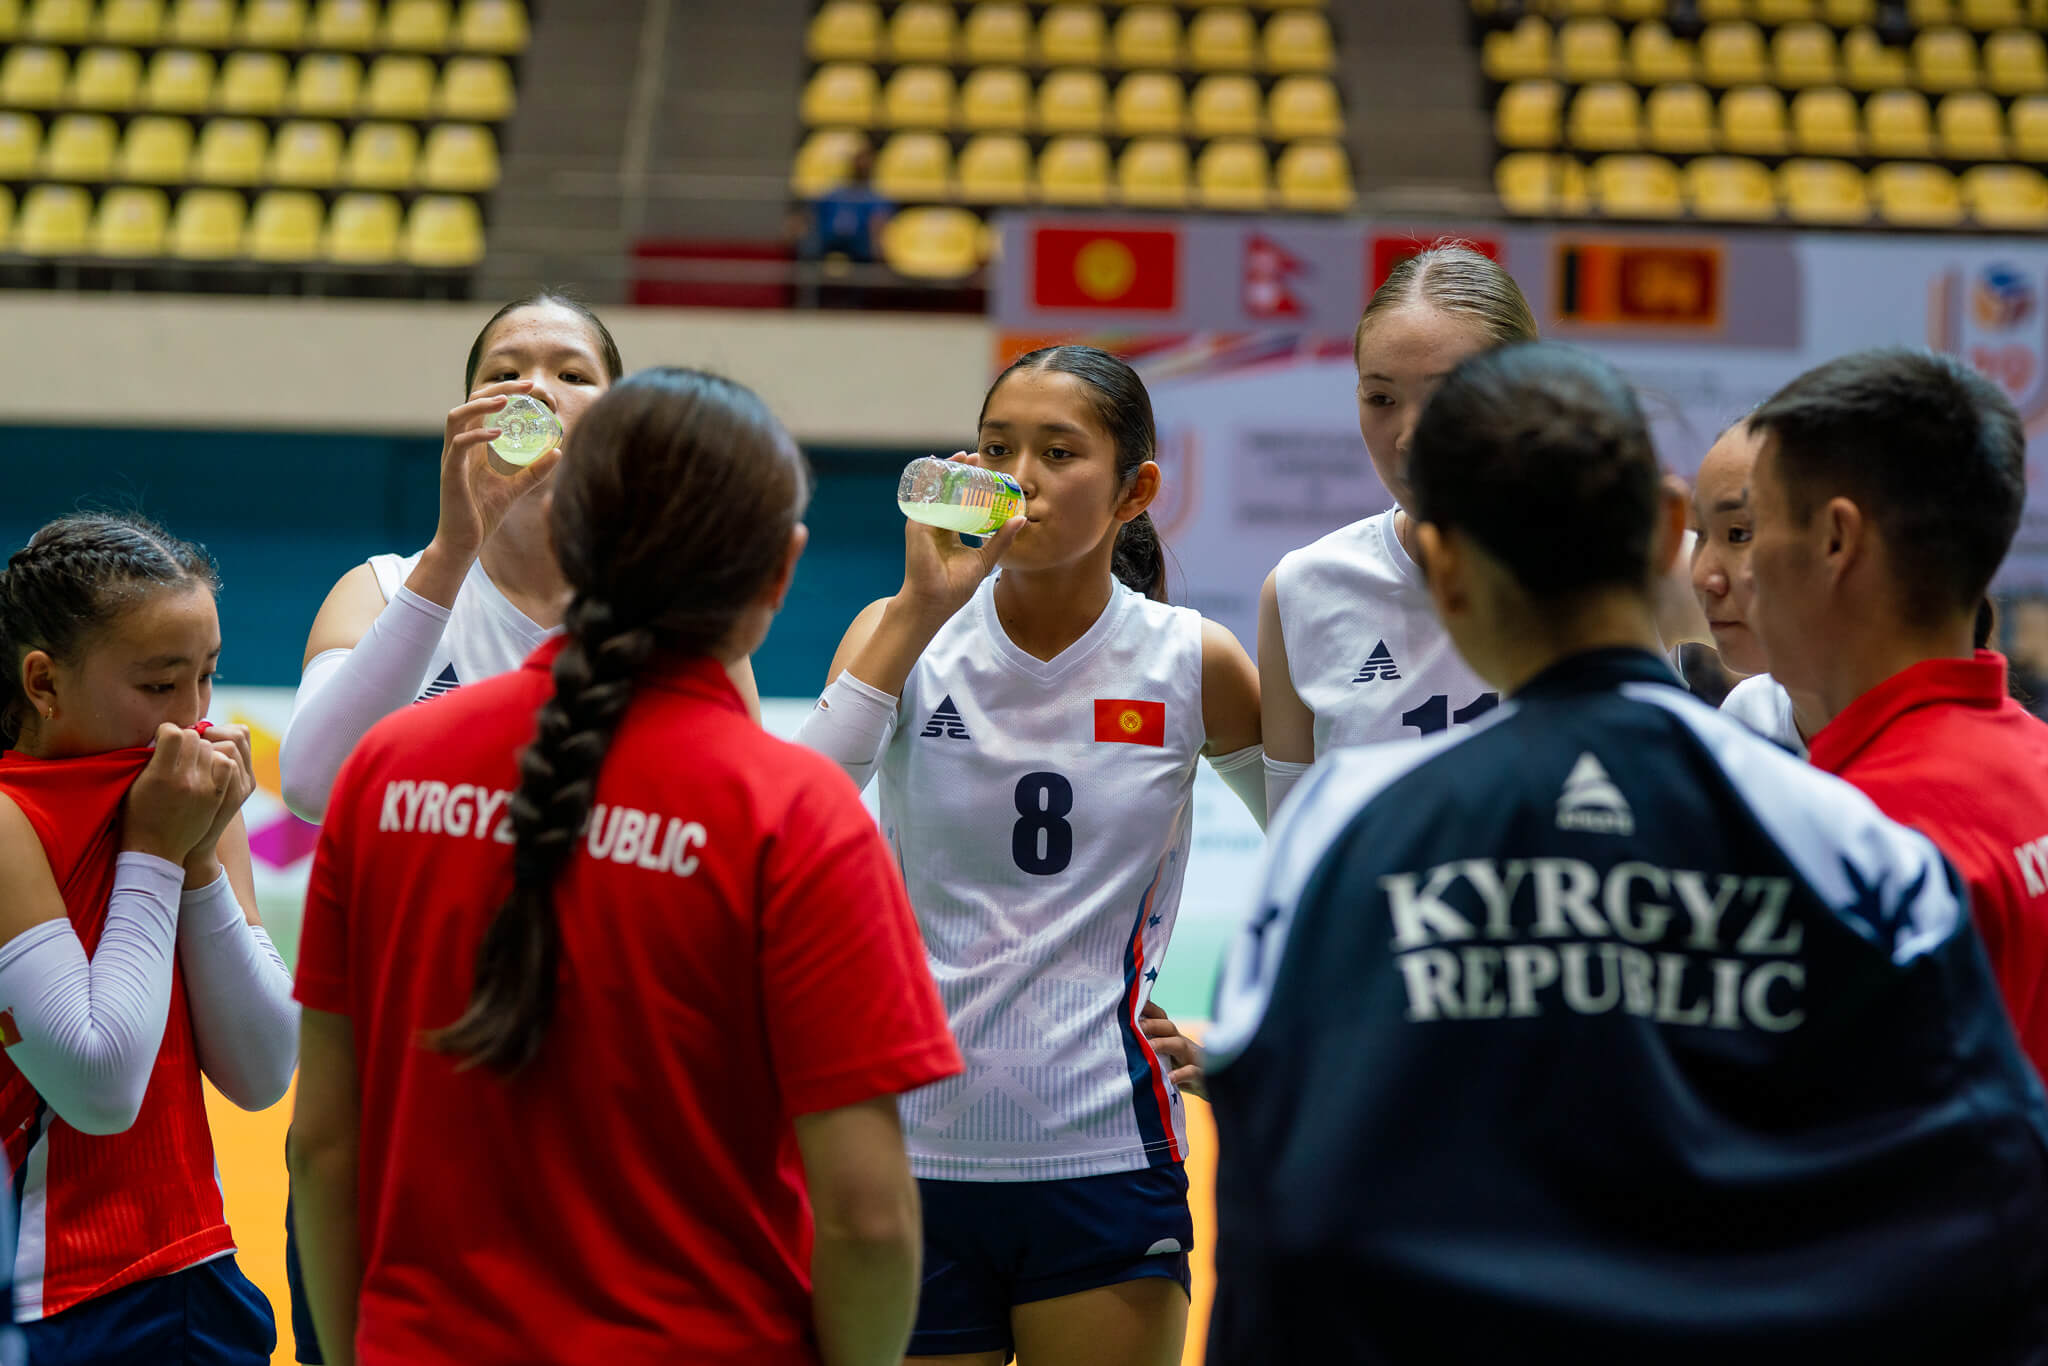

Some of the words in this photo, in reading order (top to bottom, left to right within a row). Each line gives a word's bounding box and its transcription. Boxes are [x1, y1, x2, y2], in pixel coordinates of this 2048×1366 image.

[1402, 692, 1499, 737] 1
[580, 804, 707, 878] UBLIC
[1012, 771, 1073, 876] 8
[1382, 857, 1804, 955] KYRGYZ
[1400, 943, 1807, 1033] REPUBLIC
